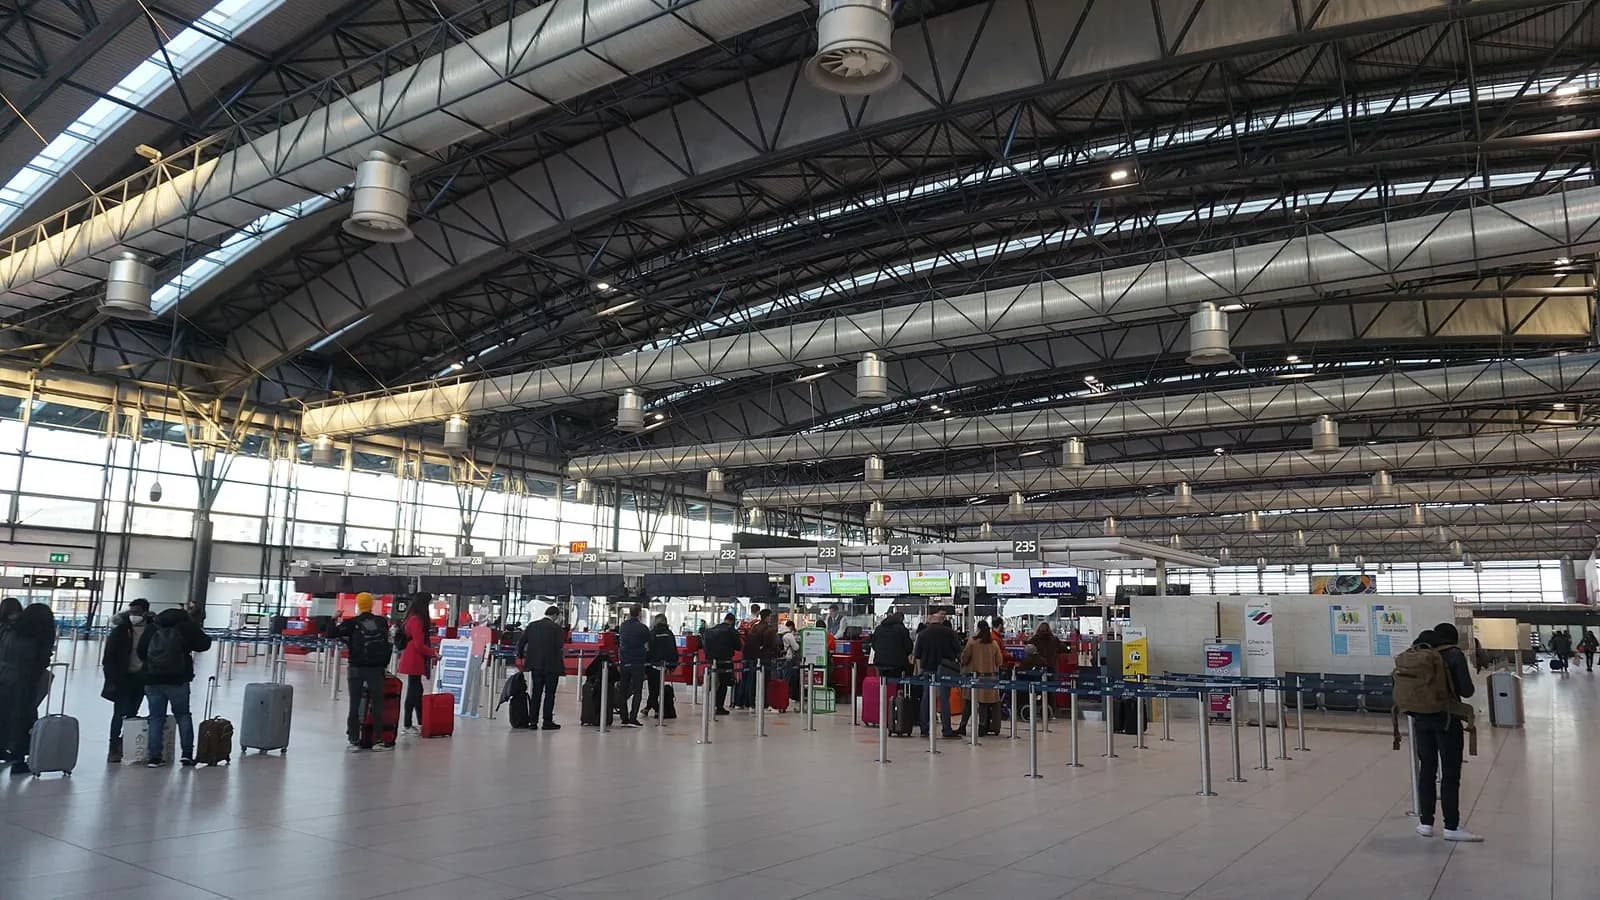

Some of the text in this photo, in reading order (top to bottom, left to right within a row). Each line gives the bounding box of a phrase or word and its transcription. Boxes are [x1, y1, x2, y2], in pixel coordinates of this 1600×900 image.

[890, 545, 909, 556] 234
[1015, 540, 1036, 552] 235
[664, 551, 677, 561] 231
[721, 549, 736, 560] 232
[819, 547, 836, 558] 233
[537, 554, 549, 564] 229
[583, 553, 597, 563] 230
[57, 577, 67, 587] P
[1038, 581, 1071, 589] PREMIUM
